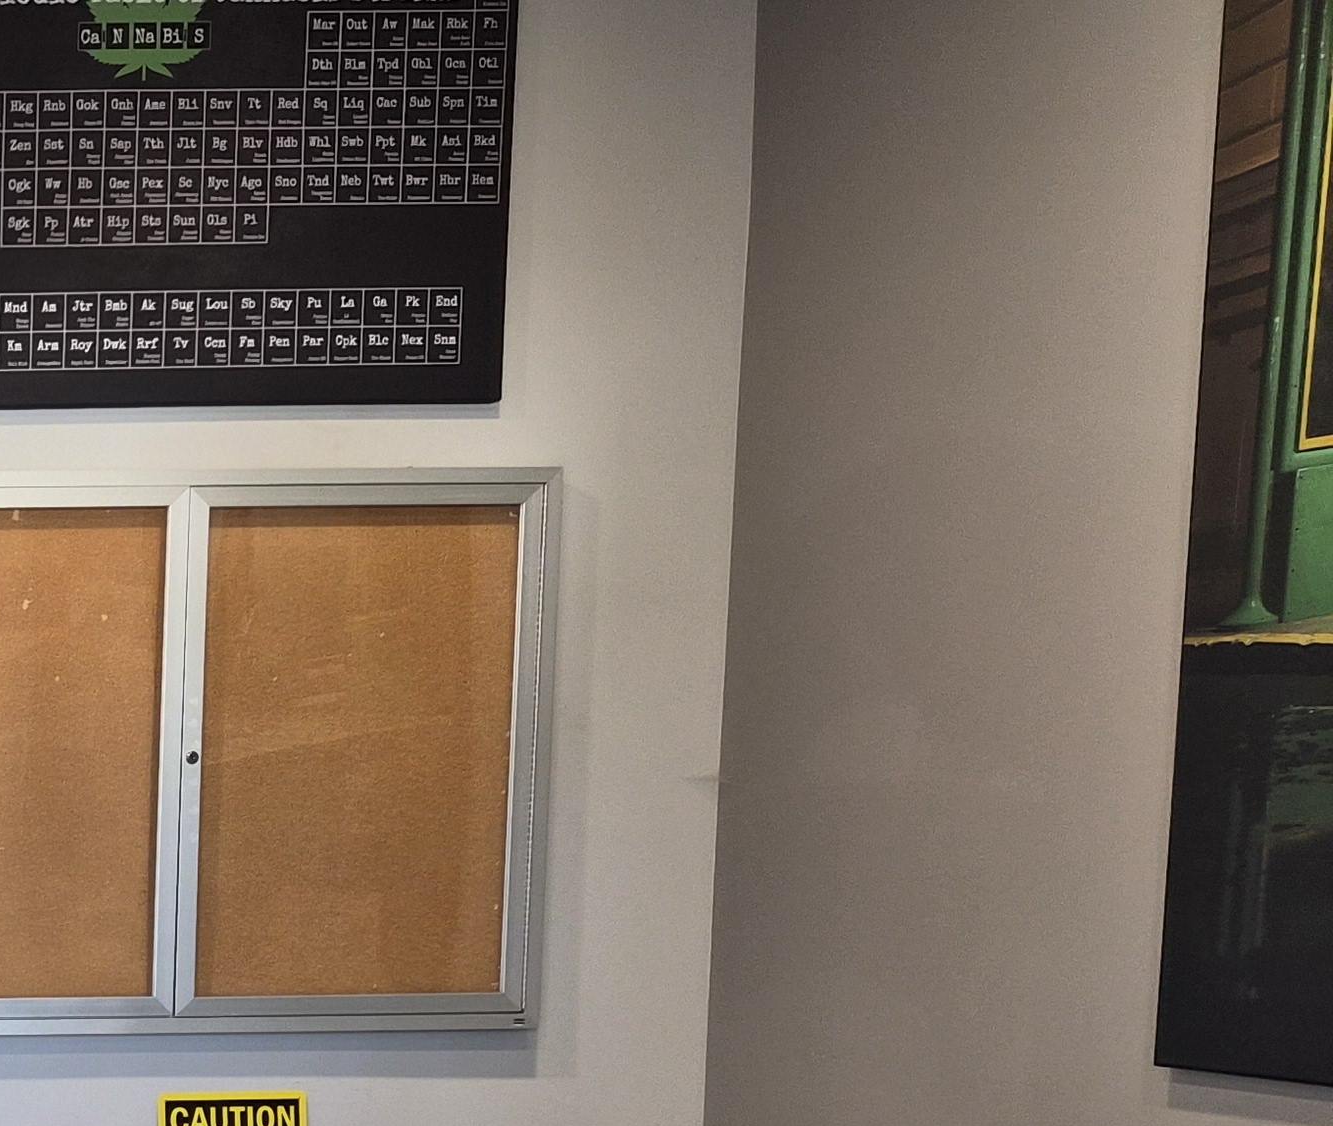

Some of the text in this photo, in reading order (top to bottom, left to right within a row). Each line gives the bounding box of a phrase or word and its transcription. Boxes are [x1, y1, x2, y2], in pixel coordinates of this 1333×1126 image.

[346, 18, 368, 30] Out
[382, 18, 398, 30] Aw
[81, 28, 204, 44] Ca N Na Bi S
[377, 58, 399, 72] Tpd
[277, 97, 299, 109] Red
[409, 96, 431, 108] Sub
[9, 134, 496, 152] Zen Sap Bkd
[142, 177, 164, 189] Pex
[207, 176, 229, 190] Nyc
[341, 174, 362, 186] Neb
[173, 214, 196, 226] Sun
[3, 301, 28, 314] Mnd
[171, 298, 195, 312] Sug
[205, 297, 229, 310] Lou
[269, 297, 293, 312] Sky
[435, 294, 458, 307] End
[69, 334, 424, 353] Roy Pen Par Nex
